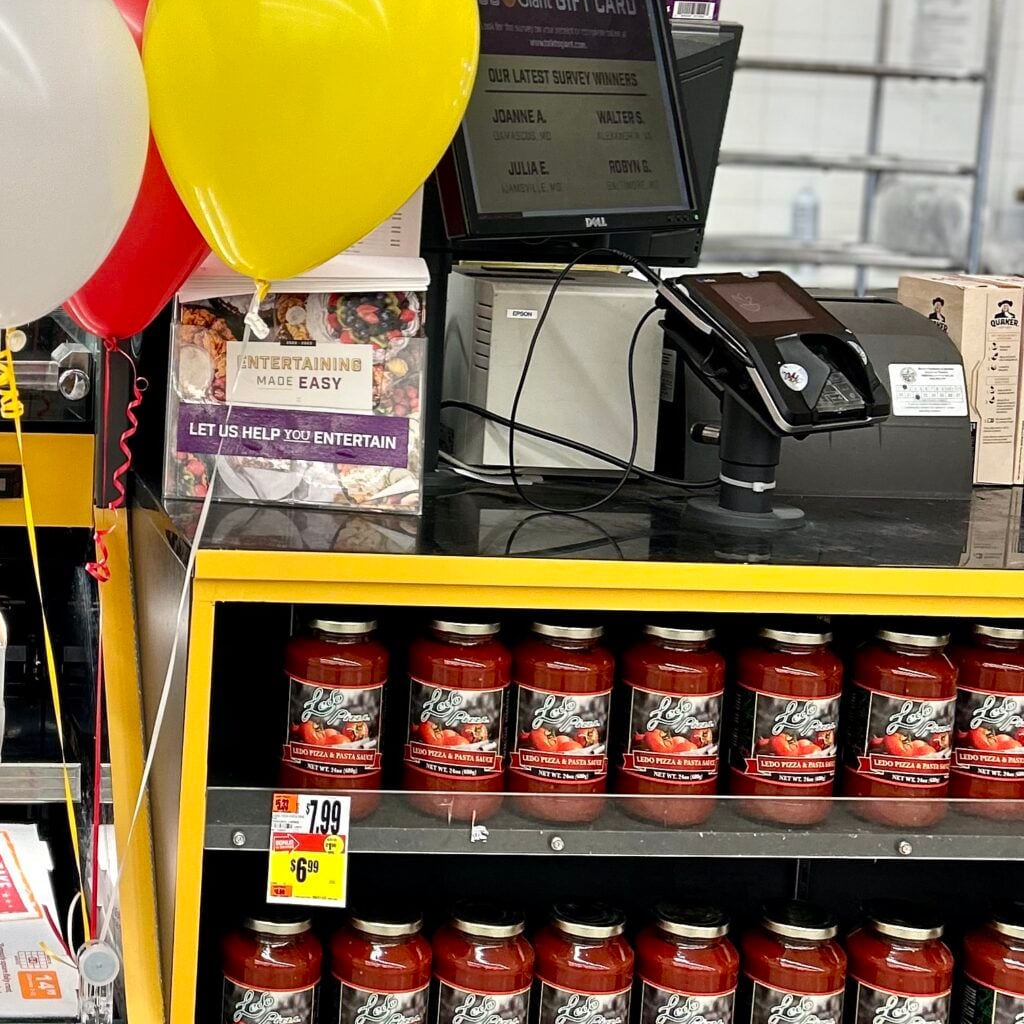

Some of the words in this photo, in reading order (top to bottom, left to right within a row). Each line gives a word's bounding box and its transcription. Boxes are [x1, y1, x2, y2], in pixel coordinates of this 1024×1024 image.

[488, 68, 510, 83] OUR
[513, 69, 549, 85] LATEST
[553, 71, 590, 86] SURVEY
[592, 72, 638, 87] WINNERS
[493, 109, 534, 124] JOANNE
[596, 111, 635, 125] WALTER
[508, 161, 538, 176] JULIA
[512, 310, 533, 318] EPSON
[990, 318, 1018, 327] QUAKER
[237, 355, 362, 372] ENTERTAINING
[257, 375, 293, 386] MADE
[299, 376, 342, 390] EASY
[189, 422, 216, 436] LET
[219, 424, 238, 438] US
[242, 426, 281, 441] HELP
[283, 429, 310, 442] YOU
[314, 432, 397, 450] ENTERTAIN
[309, 749, 328, 757] PIZZA
[336, 752, 355, 760] PASTA
